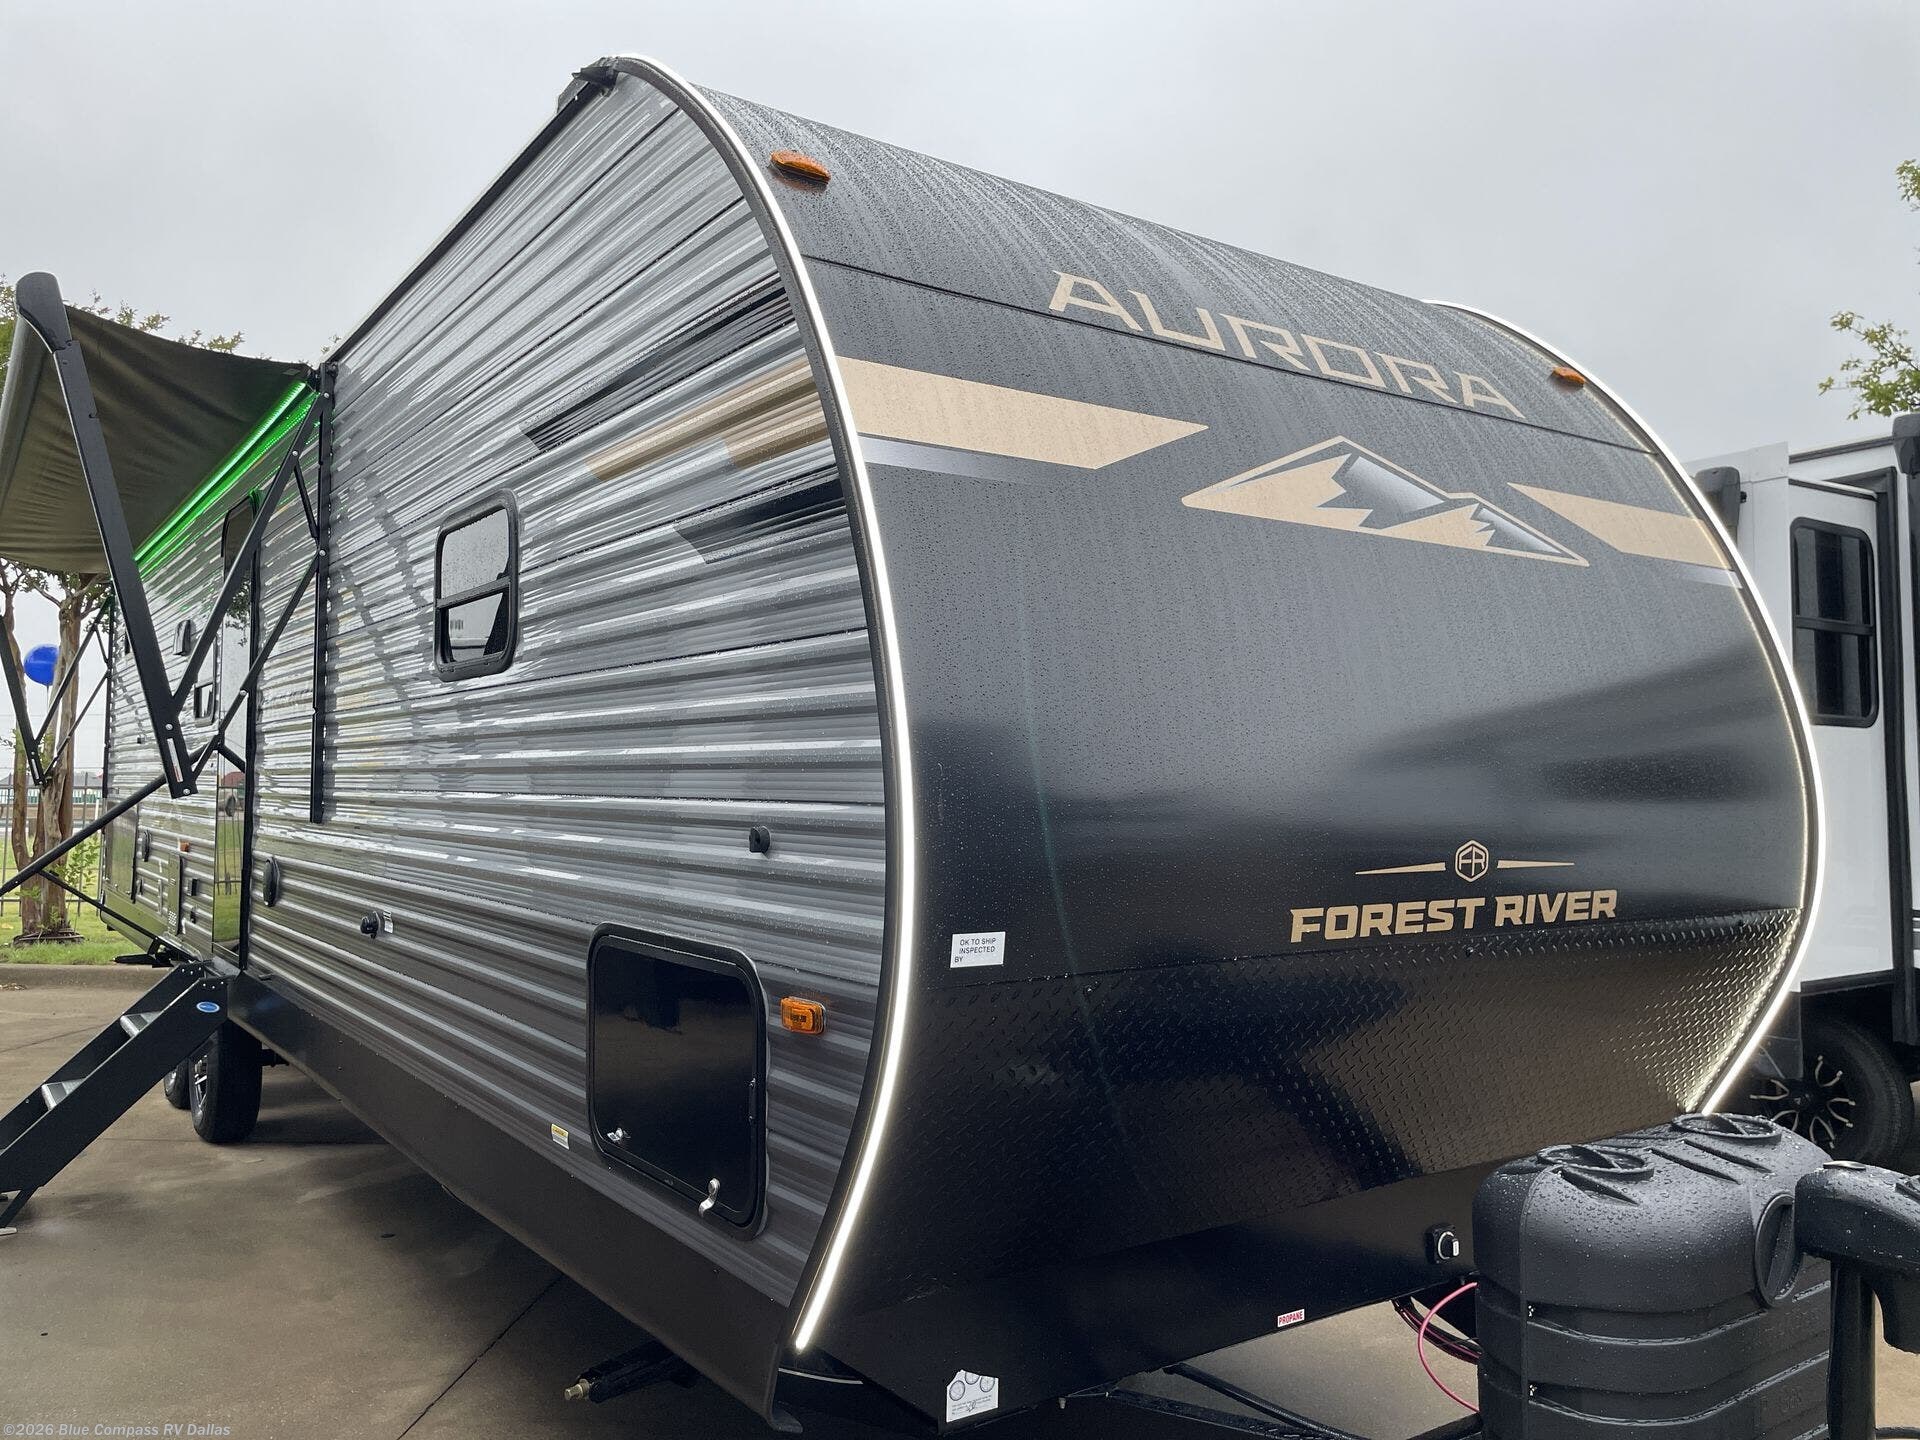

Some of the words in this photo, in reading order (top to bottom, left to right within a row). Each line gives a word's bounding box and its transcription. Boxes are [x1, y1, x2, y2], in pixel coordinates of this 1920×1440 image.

[1048, 270, 1526, 419] AURORA
[1290, 896, 1486, 943] FOREST
[1494, 889, 1618, 927] RIVER
[958, 945, 996, 954] INSPECTED
[1279, 1311, 1303, 1325] PROPANE
